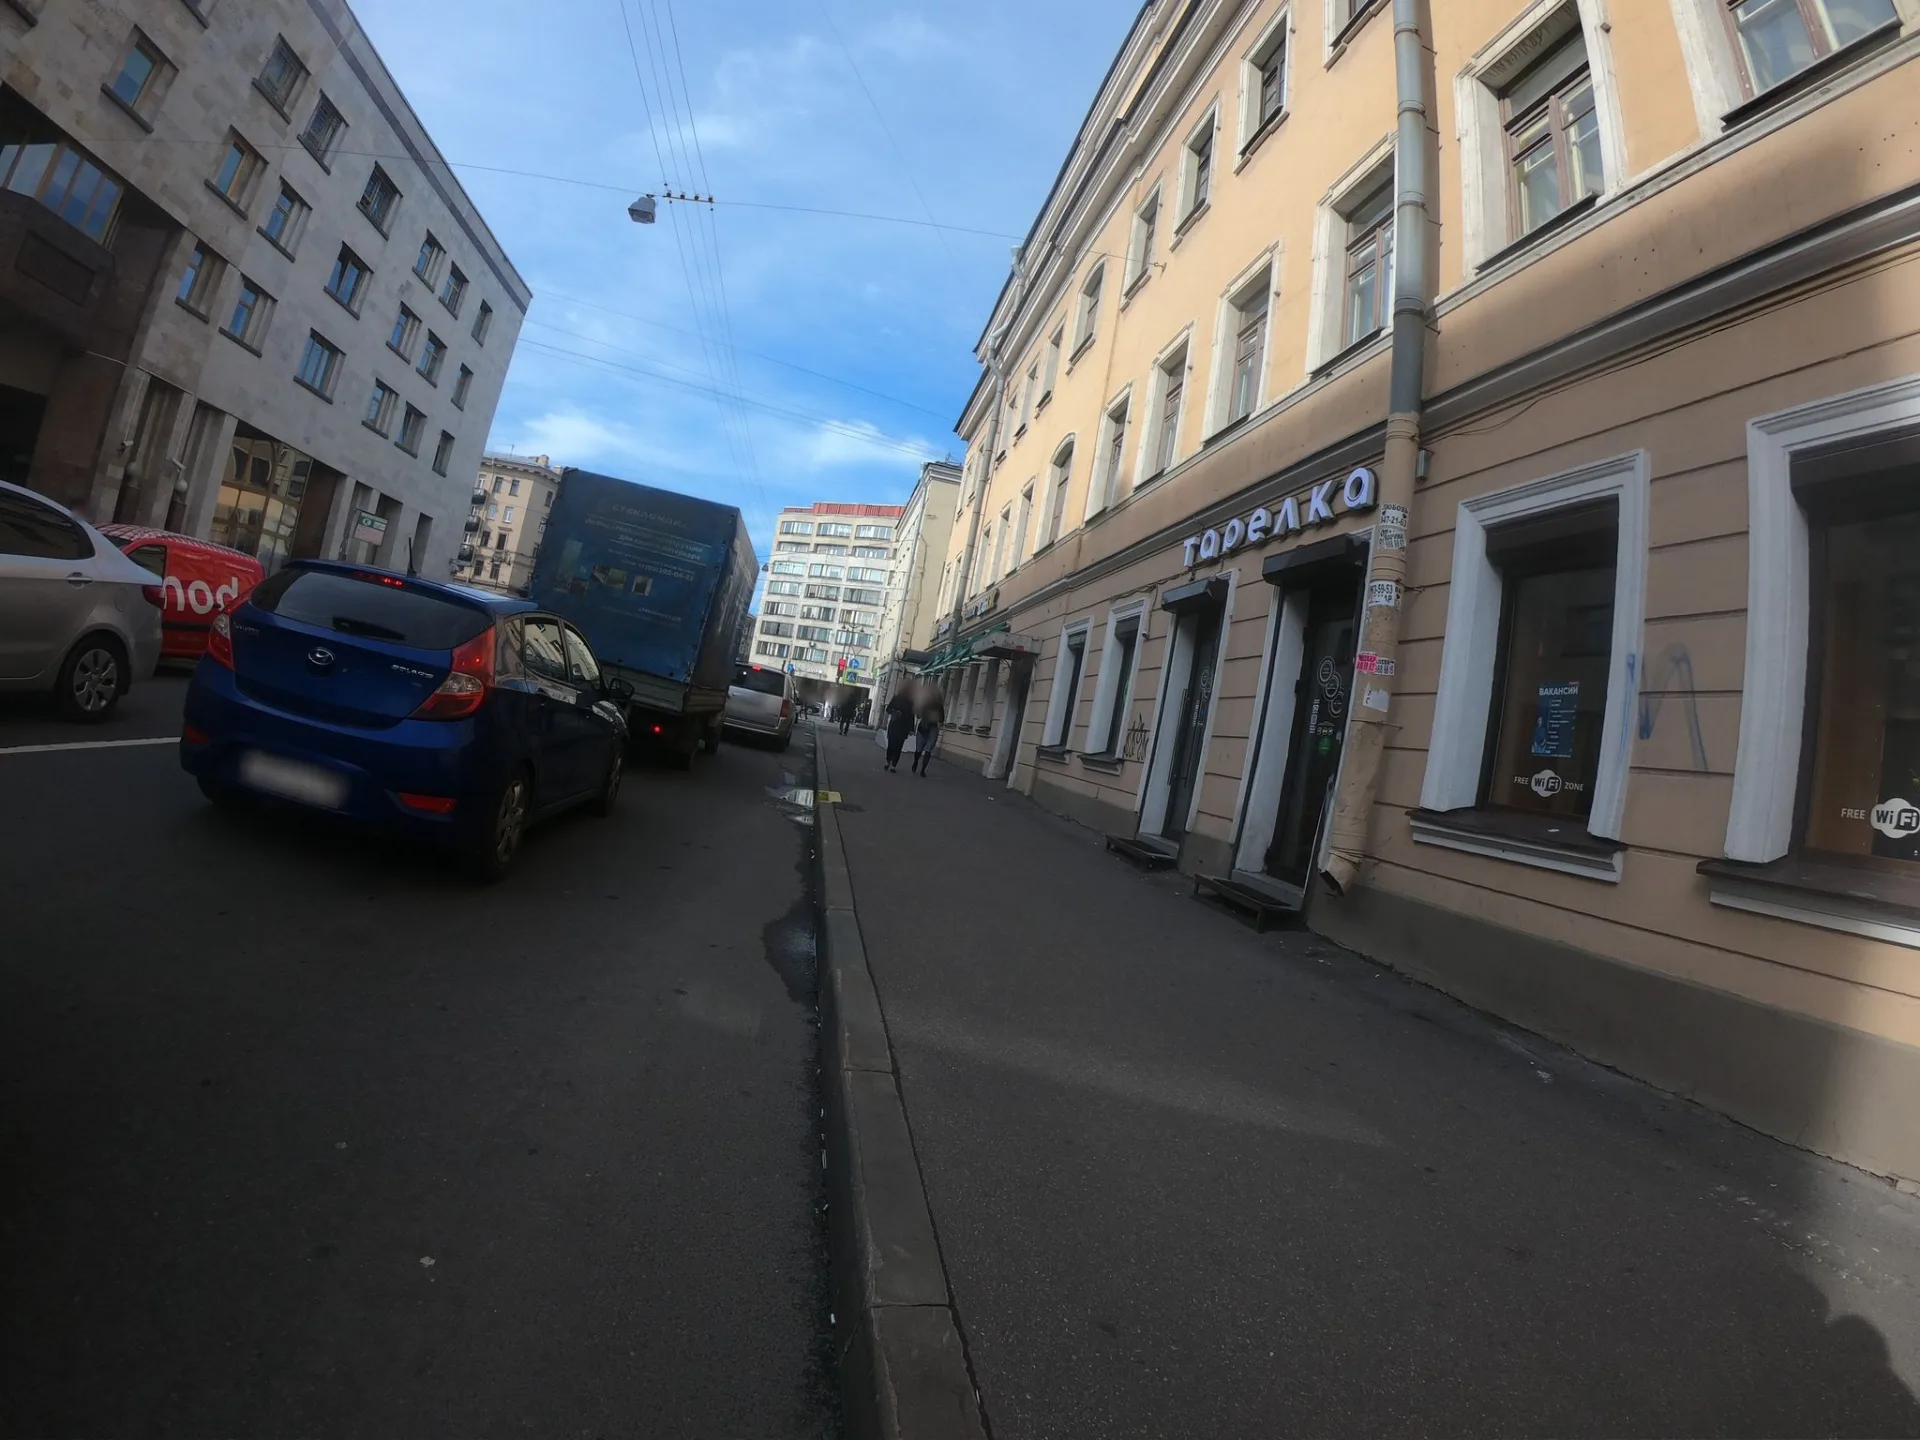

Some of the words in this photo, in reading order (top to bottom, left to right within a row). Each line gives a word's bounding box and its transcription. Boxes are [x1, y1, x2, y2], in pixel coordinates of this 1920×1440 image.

[1183, 467, 1375, 567] тарелка
[1538, 685, 1579, 696] ВАКАНСИИ
[1513, 776, 1530, 785] FREE
[1563, 782, 1584, 791] ZONE
[1840, 807, 1866, 820] FREE
